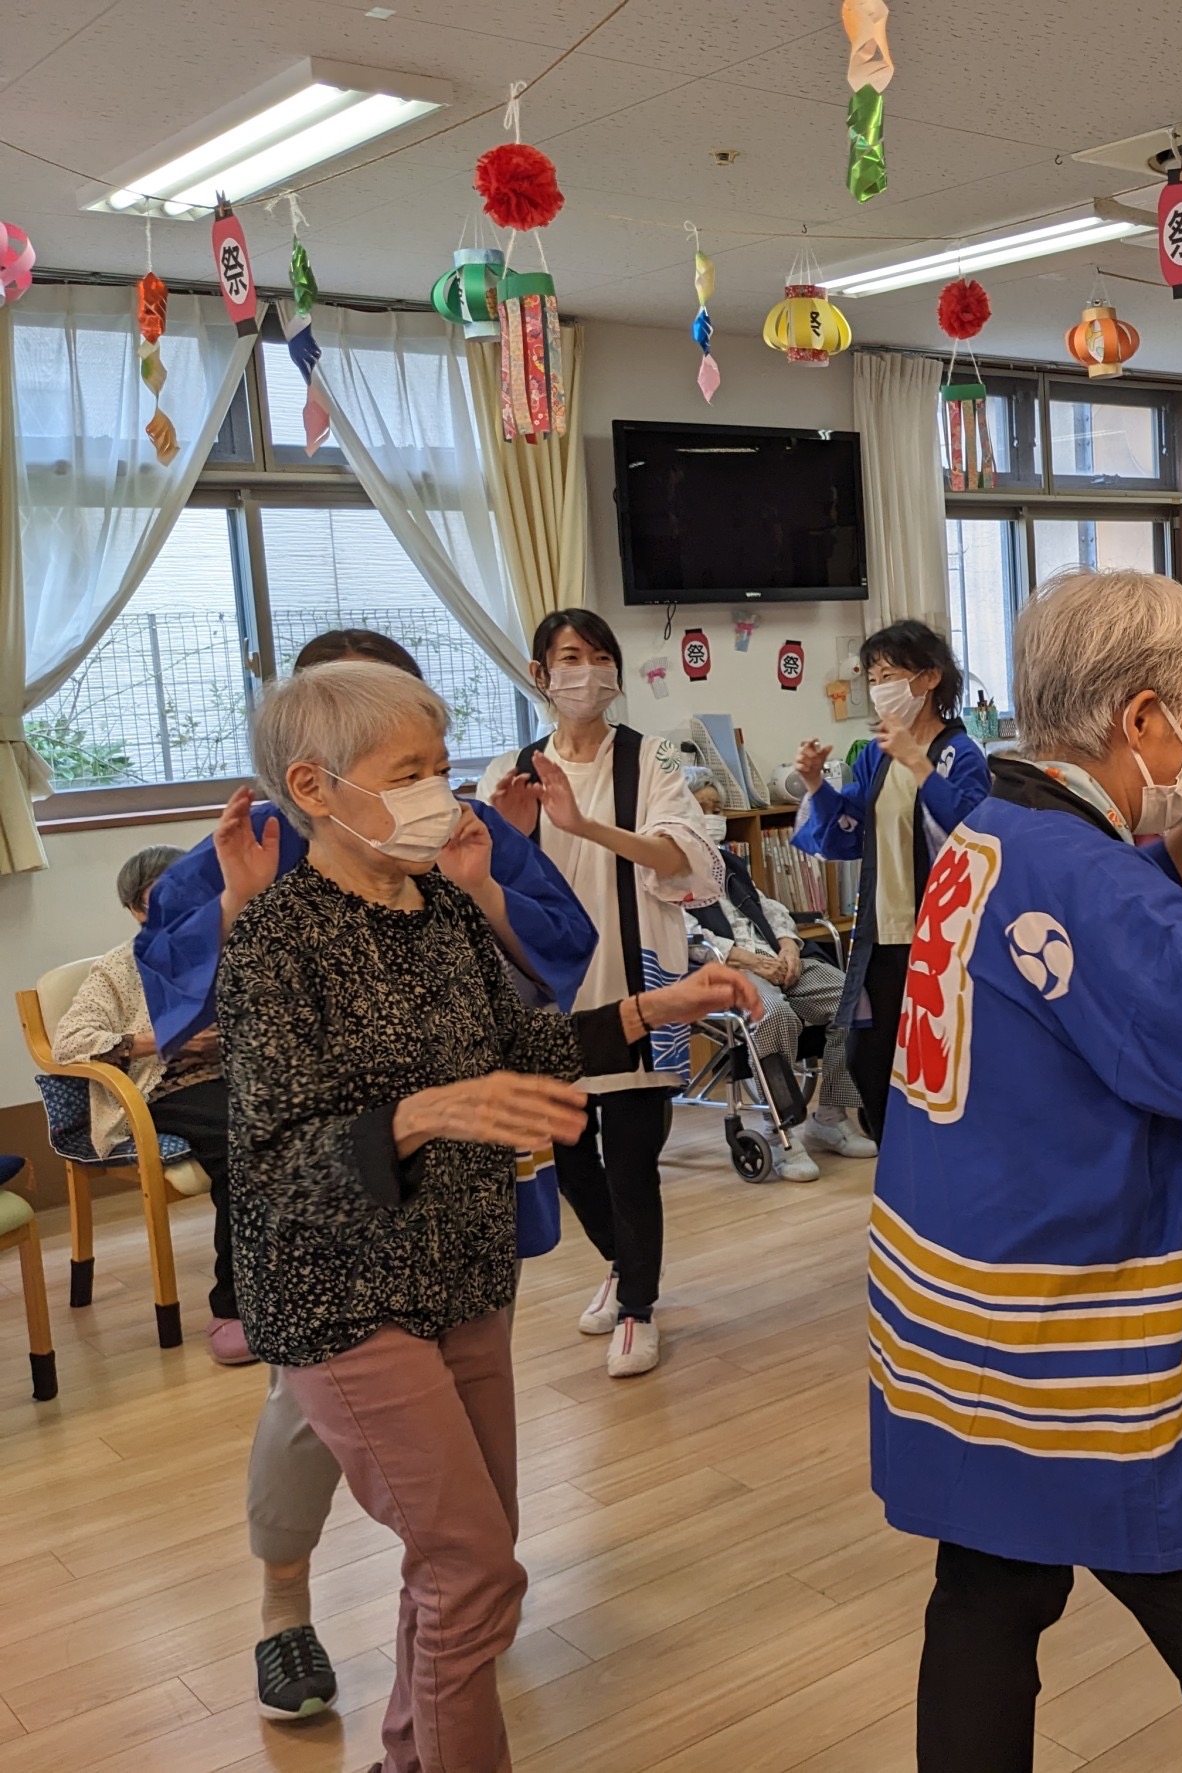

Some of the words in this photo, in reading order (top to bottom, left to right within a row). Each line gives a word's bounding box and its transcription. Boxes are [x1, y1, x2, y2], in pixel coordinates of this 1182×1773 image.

[221, 246, 247, 296] 祭
[687, 644, 705, 664] 祭
[783, 655, 799, 675] 祭
[897, 845, 973, 1094] 祭
